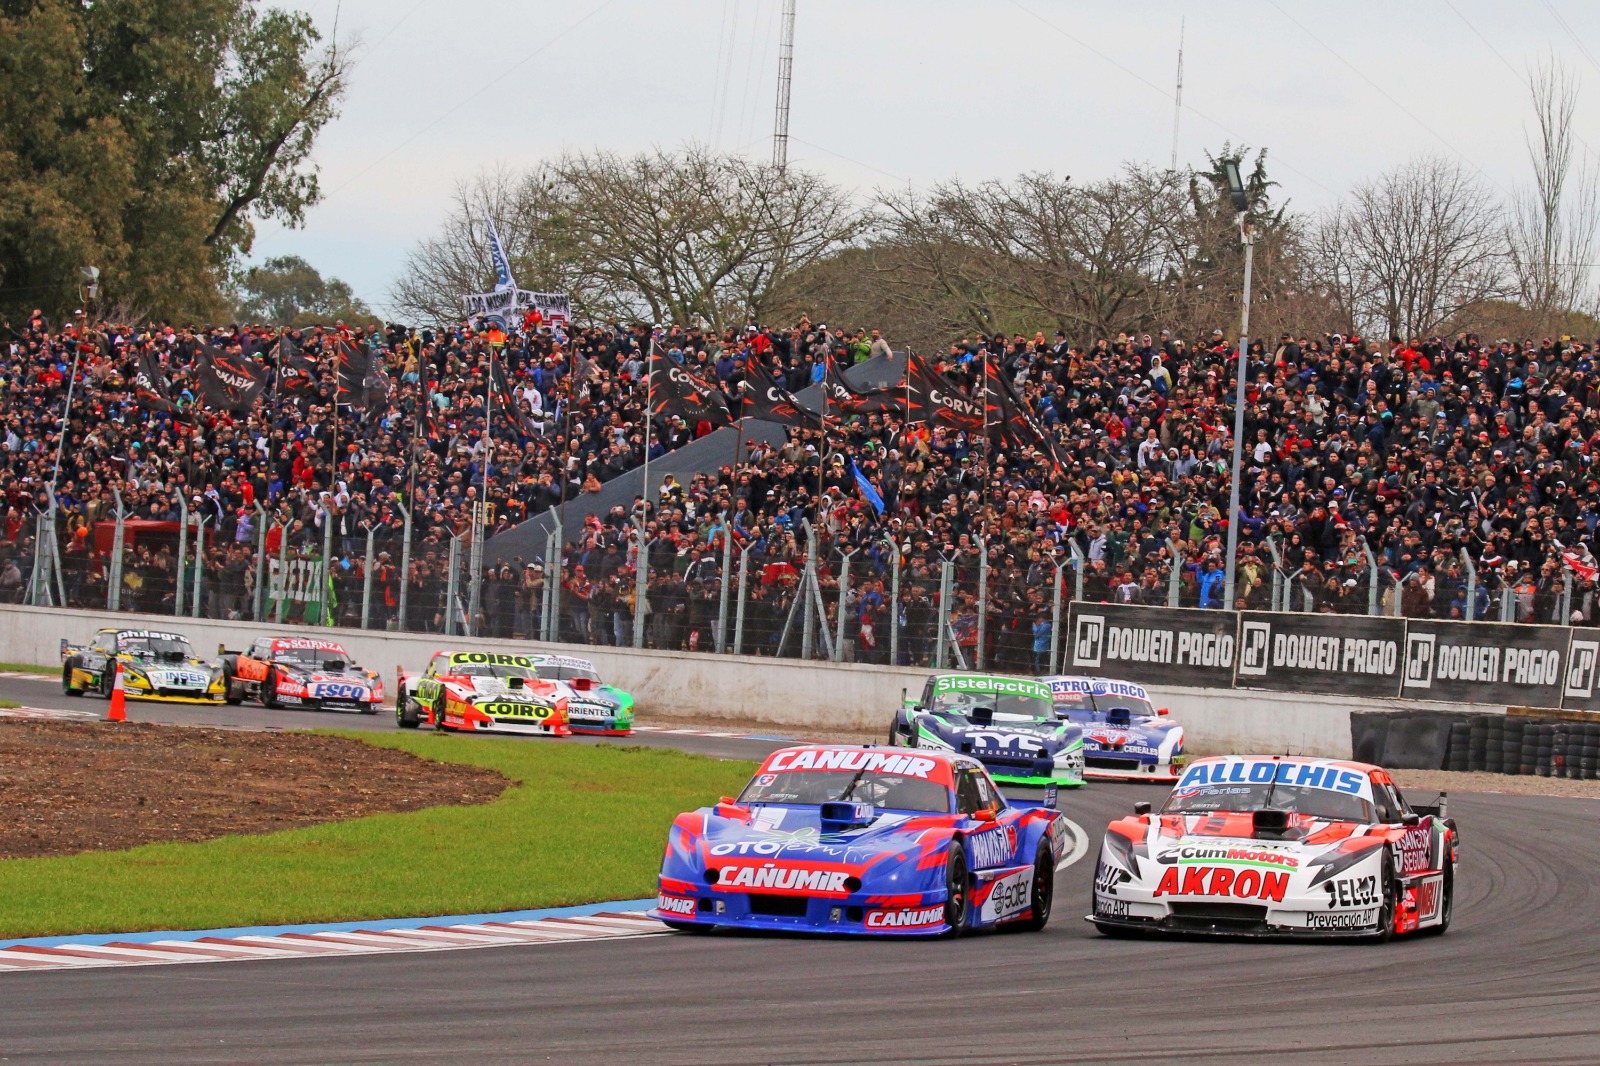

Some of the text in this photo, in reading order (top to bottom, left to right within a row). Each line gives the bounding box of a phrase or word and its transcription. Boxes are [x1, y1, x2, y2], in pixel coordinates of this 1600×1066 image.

[485, 291, 513, 311] MISMO
[290, 639, 345, 653] SCIENZA
[1106, 627, 1234, 668] DOWEN PAGIO
[1273, 634, 1397, 675] DOWEN PAGIO
[453, 653, 532, 668] COIRO
[1437, 644, 1560, 685] DOWEN PAGIO
[165, 671, 207, 684] INSER
[315, 683, 364, 699] ESCO
[938, 677, 1050, 702] Sistelectric
[1110, 682, 1146, 699] URCO
[484, 703, 549, 718] COIRO
[568, 706, 611, 718] RRIENTES
[965, 732, 1043, 752] TYC
[970, 748, 1039, 759] ARGENTINA
[1179, 762, 1364, 795] ALLOCHIS
[1153, 866, 1291, 903] AKRON
[1306, 908, 1376, 927] Prevención ART
